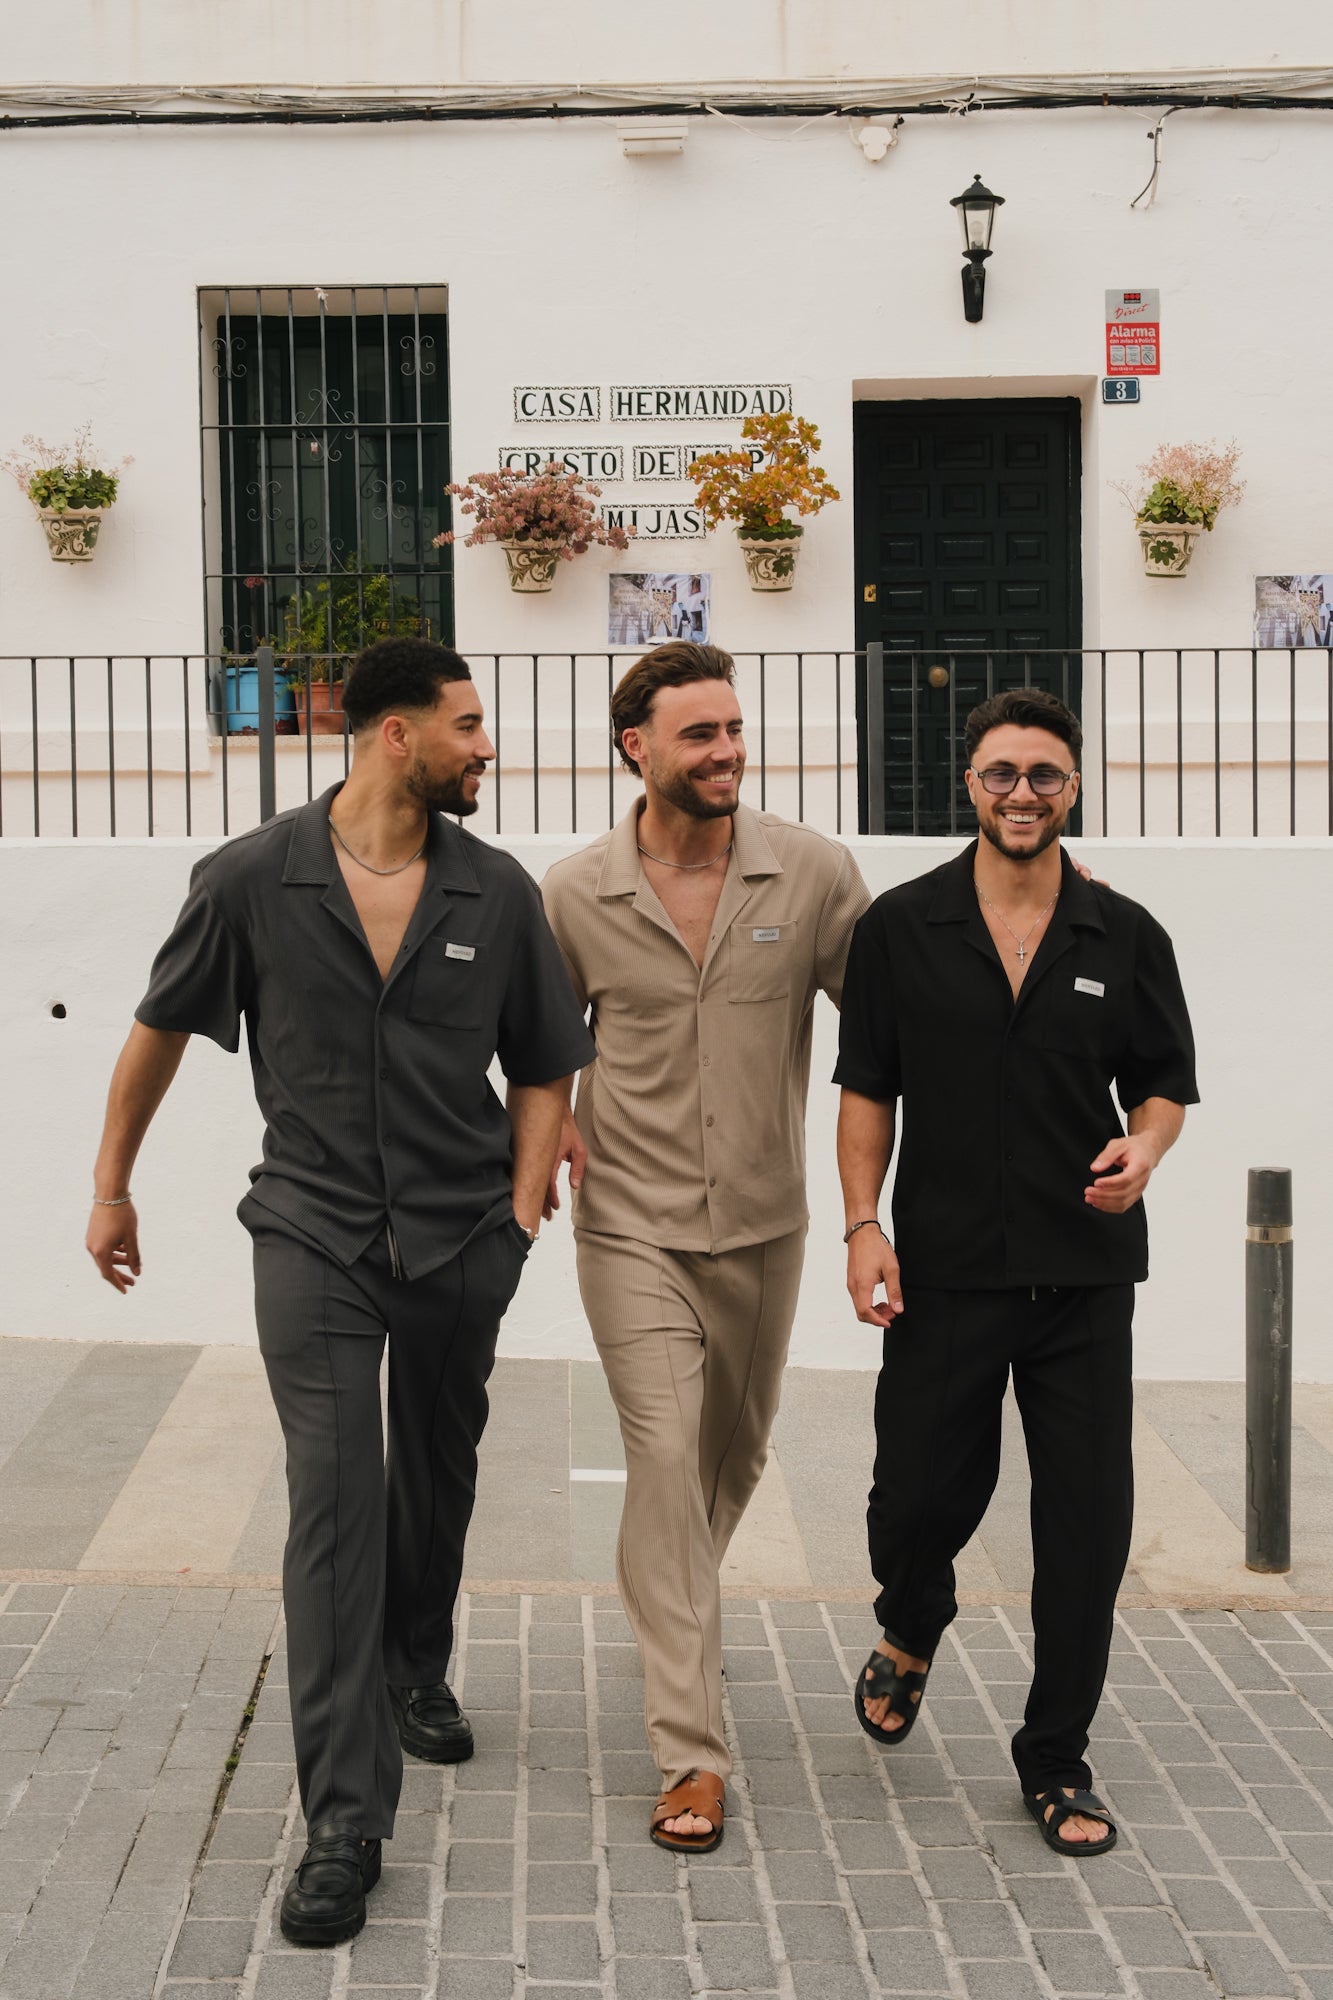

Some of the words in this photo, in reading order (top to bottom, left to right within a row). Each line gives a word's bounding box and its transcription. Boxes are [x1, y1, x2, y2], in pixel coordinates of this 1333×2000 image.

[1110, 325, 1156, 337] Alarma
[520, 391, 595, 417] CASA
[616, 389, 786, 416] HERMANDAD
[1116, 381, 1127, 400] 3
[639, 451, 676, 476] DE
[607, 509, 701, 534] MIJAS
